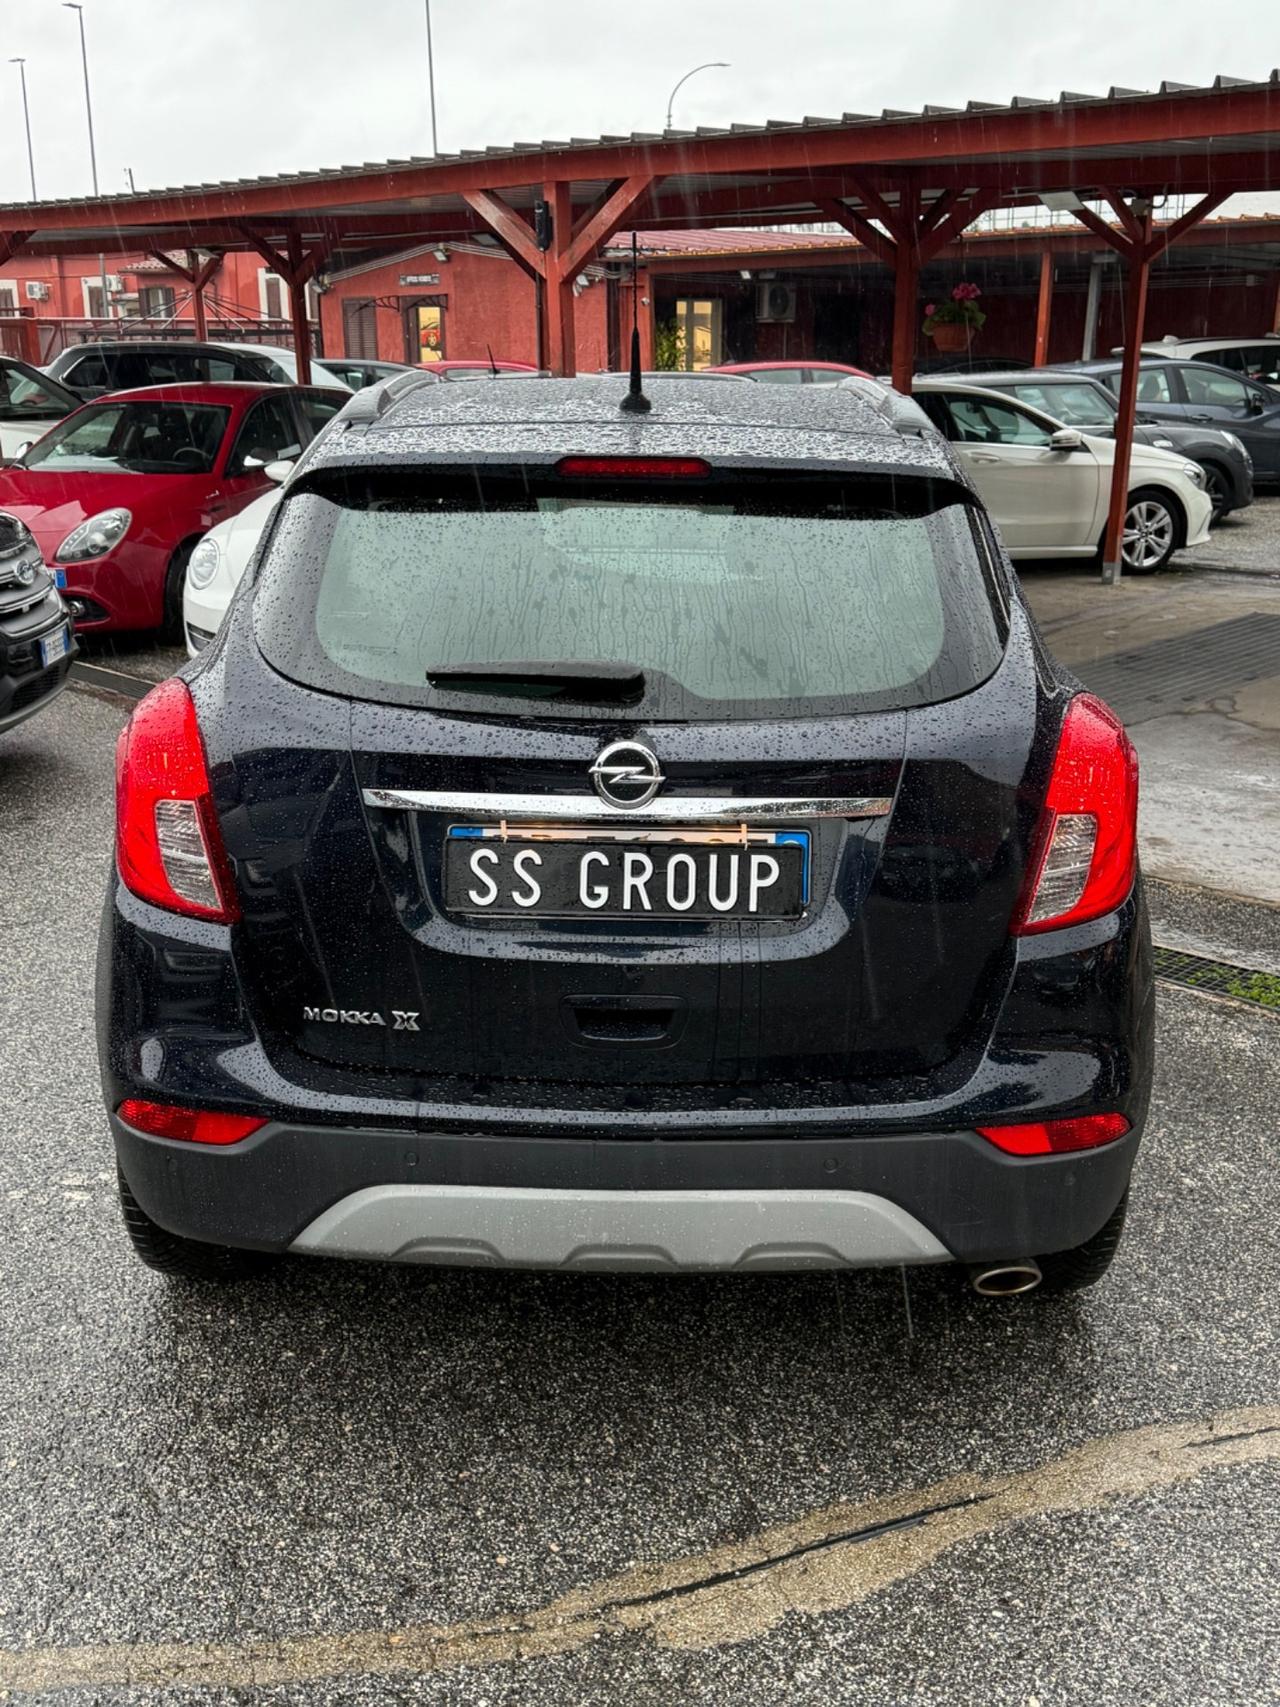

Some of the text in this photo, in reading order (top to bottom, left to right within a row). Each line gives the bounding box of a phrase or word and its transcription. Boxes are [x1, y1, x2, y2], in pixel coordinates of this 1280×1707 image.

[468, 848, 780, 912] SS GROUP
[303, 1006, 421, 1031] MOKKA X
